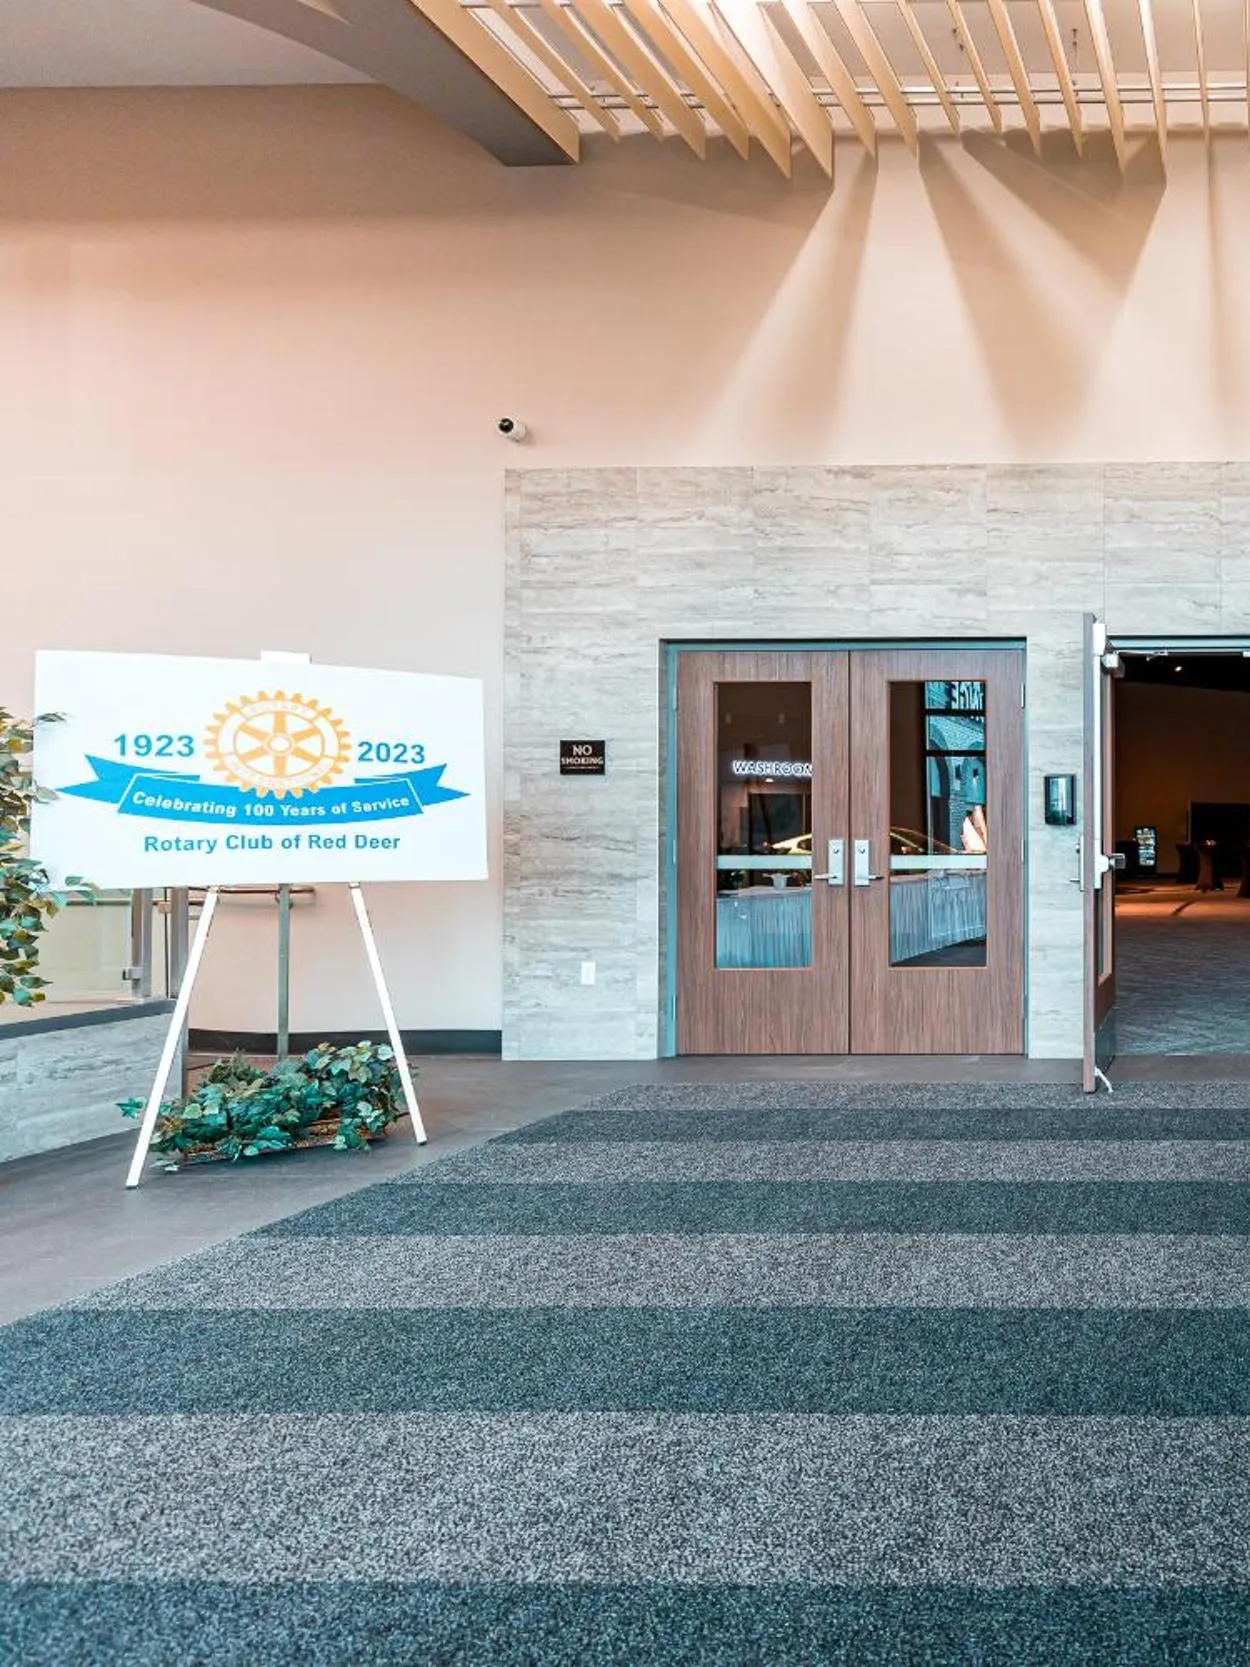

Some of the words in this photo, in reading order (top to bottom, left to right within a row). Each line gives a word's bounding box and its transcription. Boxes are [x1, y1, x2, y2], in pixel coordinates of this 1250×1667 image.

[114, 733, 194, 757] 1923
[358, 741, 425, 764] 2023
[572, 744, 593, 756] NO
[561, 757, 604, 765] SMOKING
[132, 791, 236, 817] Celebrating
[245, 804, 274, 817] 100
[280, 804, 326, 817] Years
[331, 802, 346, 814] of
[351, 796, 409, 813] Service
[144, 836, 217, 854] Rotary
[226, 834, 273, 850] Club
[281, 834, 301, 849] of
[308, 834, 346, 849] Red
[355, 834, 400, 849] Deer
